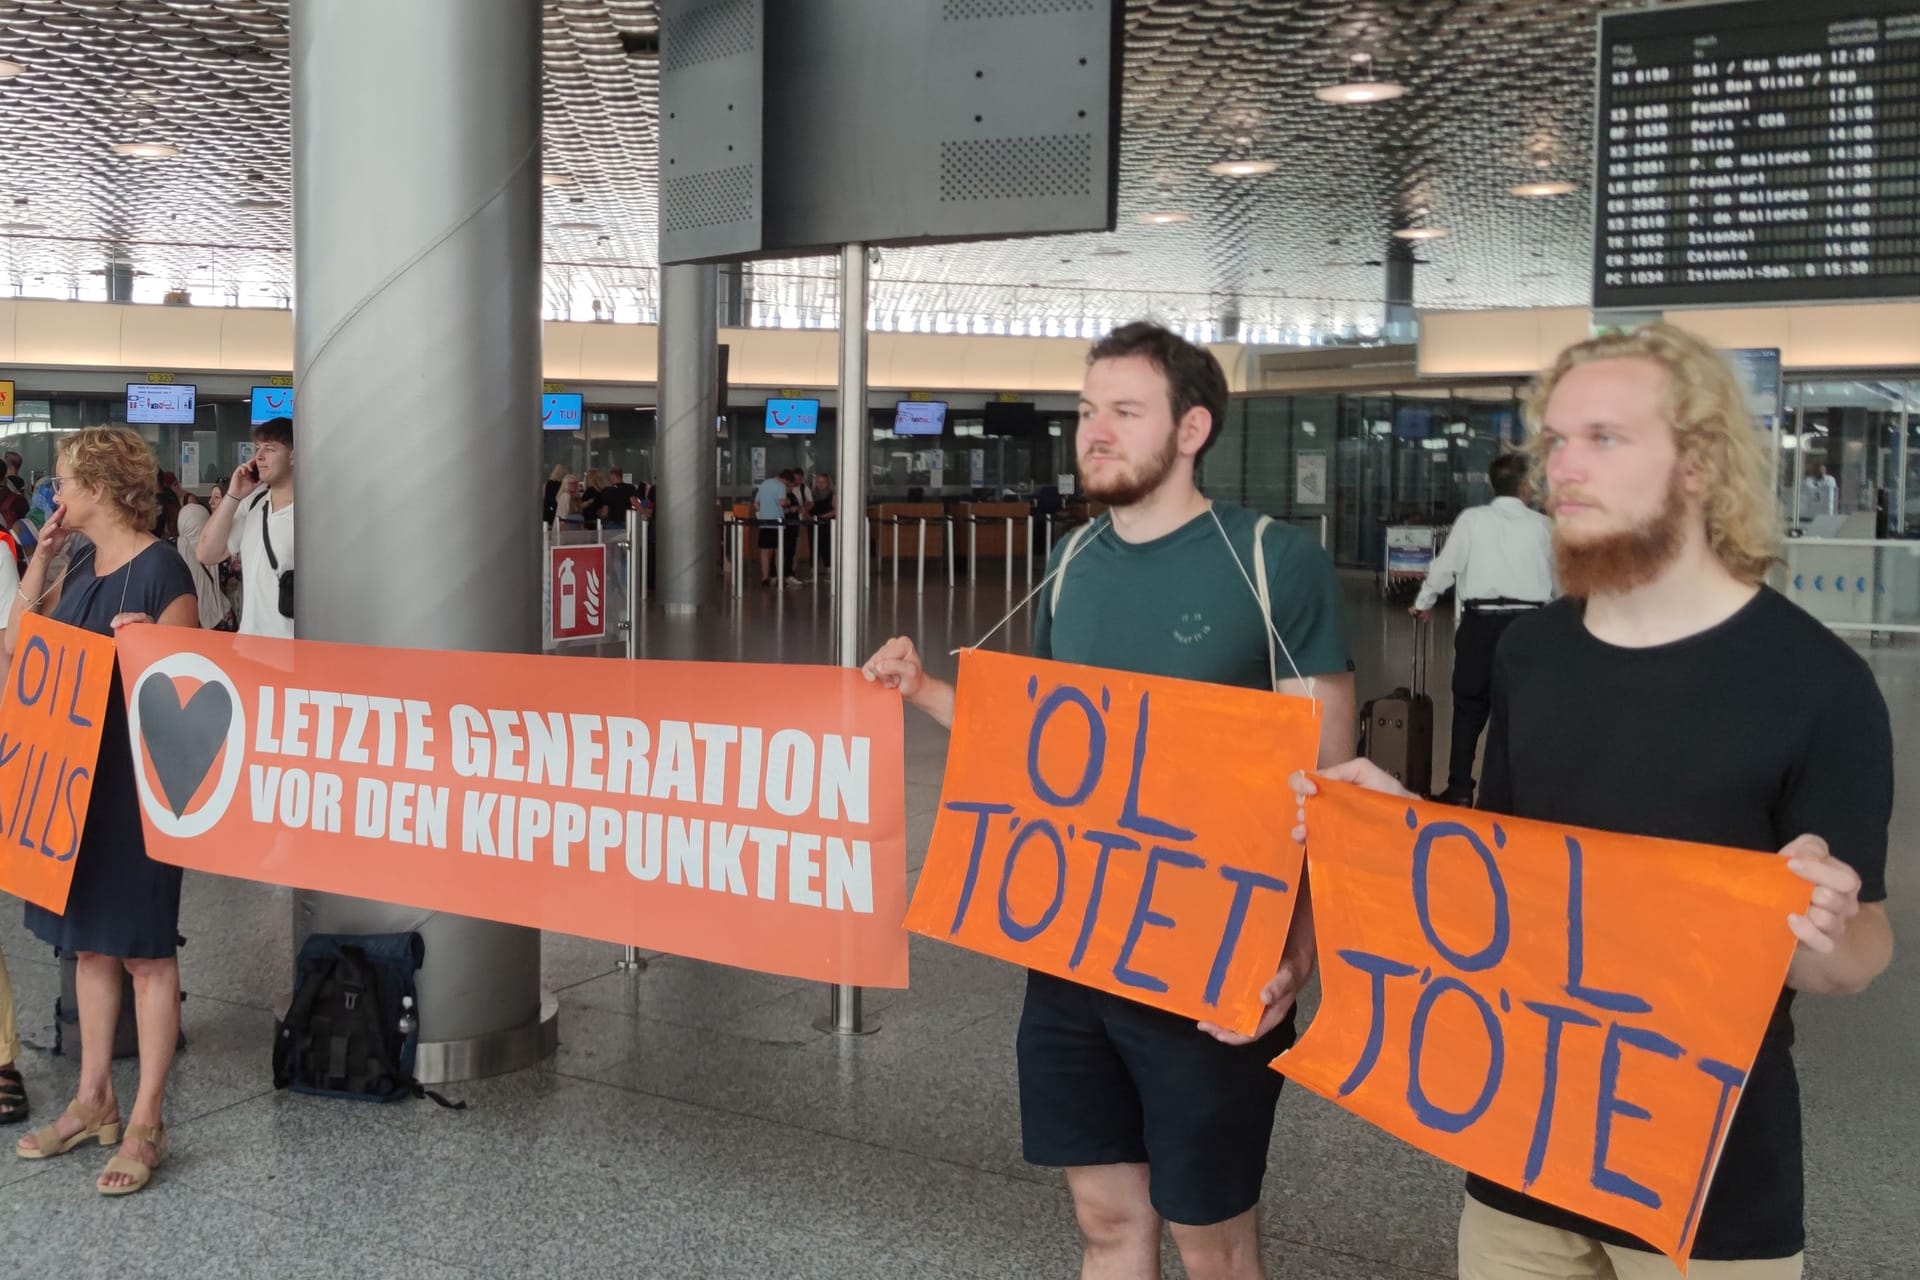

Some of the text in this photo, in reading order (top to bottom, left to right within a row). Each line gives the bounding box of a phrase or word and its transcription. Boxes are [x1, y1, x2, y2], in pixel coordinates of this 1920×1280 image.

[1692, 98, 1749, 113] Funchal
[1691, 120, 1733, 132] Paris
[1692, 139, 1734, 151] Ibiza
[1741, 151, 1810, 165] Mallorca
[1689, 172, 1764, 188] Frankfurt
[1740, 190, 1809, 203] Mallorca
[1739, 209, 1808, 222] Mallorca
[1689, 229, 1754, 244] Istanbul
[1687, 250, 1747, 262] Catania
[560, 409, 577, 419] TUI
[17, 635, 92, 728] OIL
[255, 685, 872, 825] LETZTE GENERATION
[1027, 674, 1197, 841] ÖL
[249, 763, 875, 914] VOR DEN KIPPPUNKTEN
[944, 801, 1289, 1008] TÖTET
[1406, 806, 1653, 1014] ÖL
[1336, 949, 1747, 1253] TÖTET
